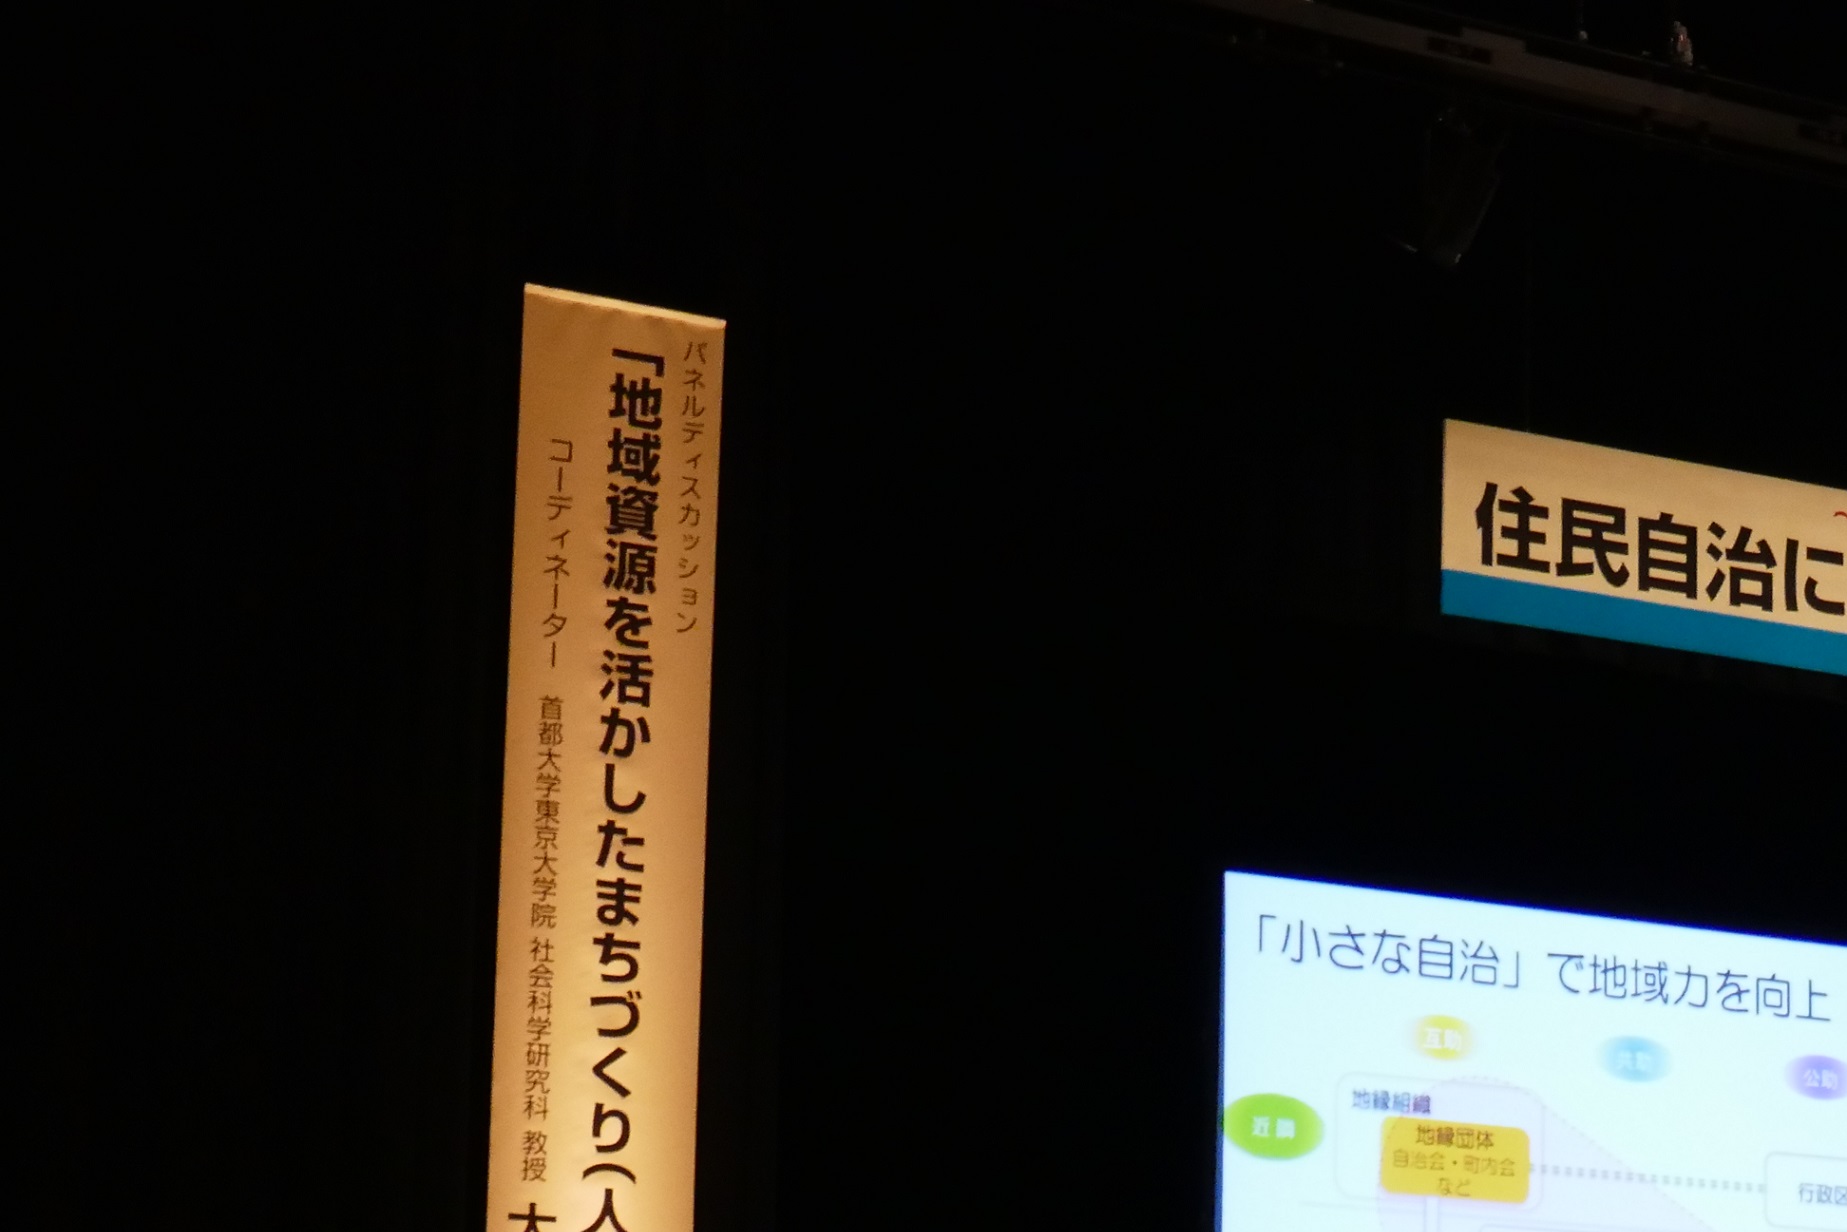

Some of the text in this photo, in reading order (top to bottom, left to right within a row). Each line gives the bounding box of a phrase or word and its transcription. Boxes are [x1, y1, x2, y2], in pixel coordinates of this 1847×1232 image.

[543, 438, 573, 668] コーディネーター
[676, 341, 708, 635] パネルディスカッション
[530, 695, 564, 929] 首都大学東京大学院
[523, 936, 554, 1121] 社会科学研究科
[1257, 912, 1831, 1023] 「小さな自治」で地域力を向上
[521, 1129, 547, 1182] 教授
[1392, 1148, 1516, 1177] 自治会・町内会
[1437, 1177, 1472, 1198] など
